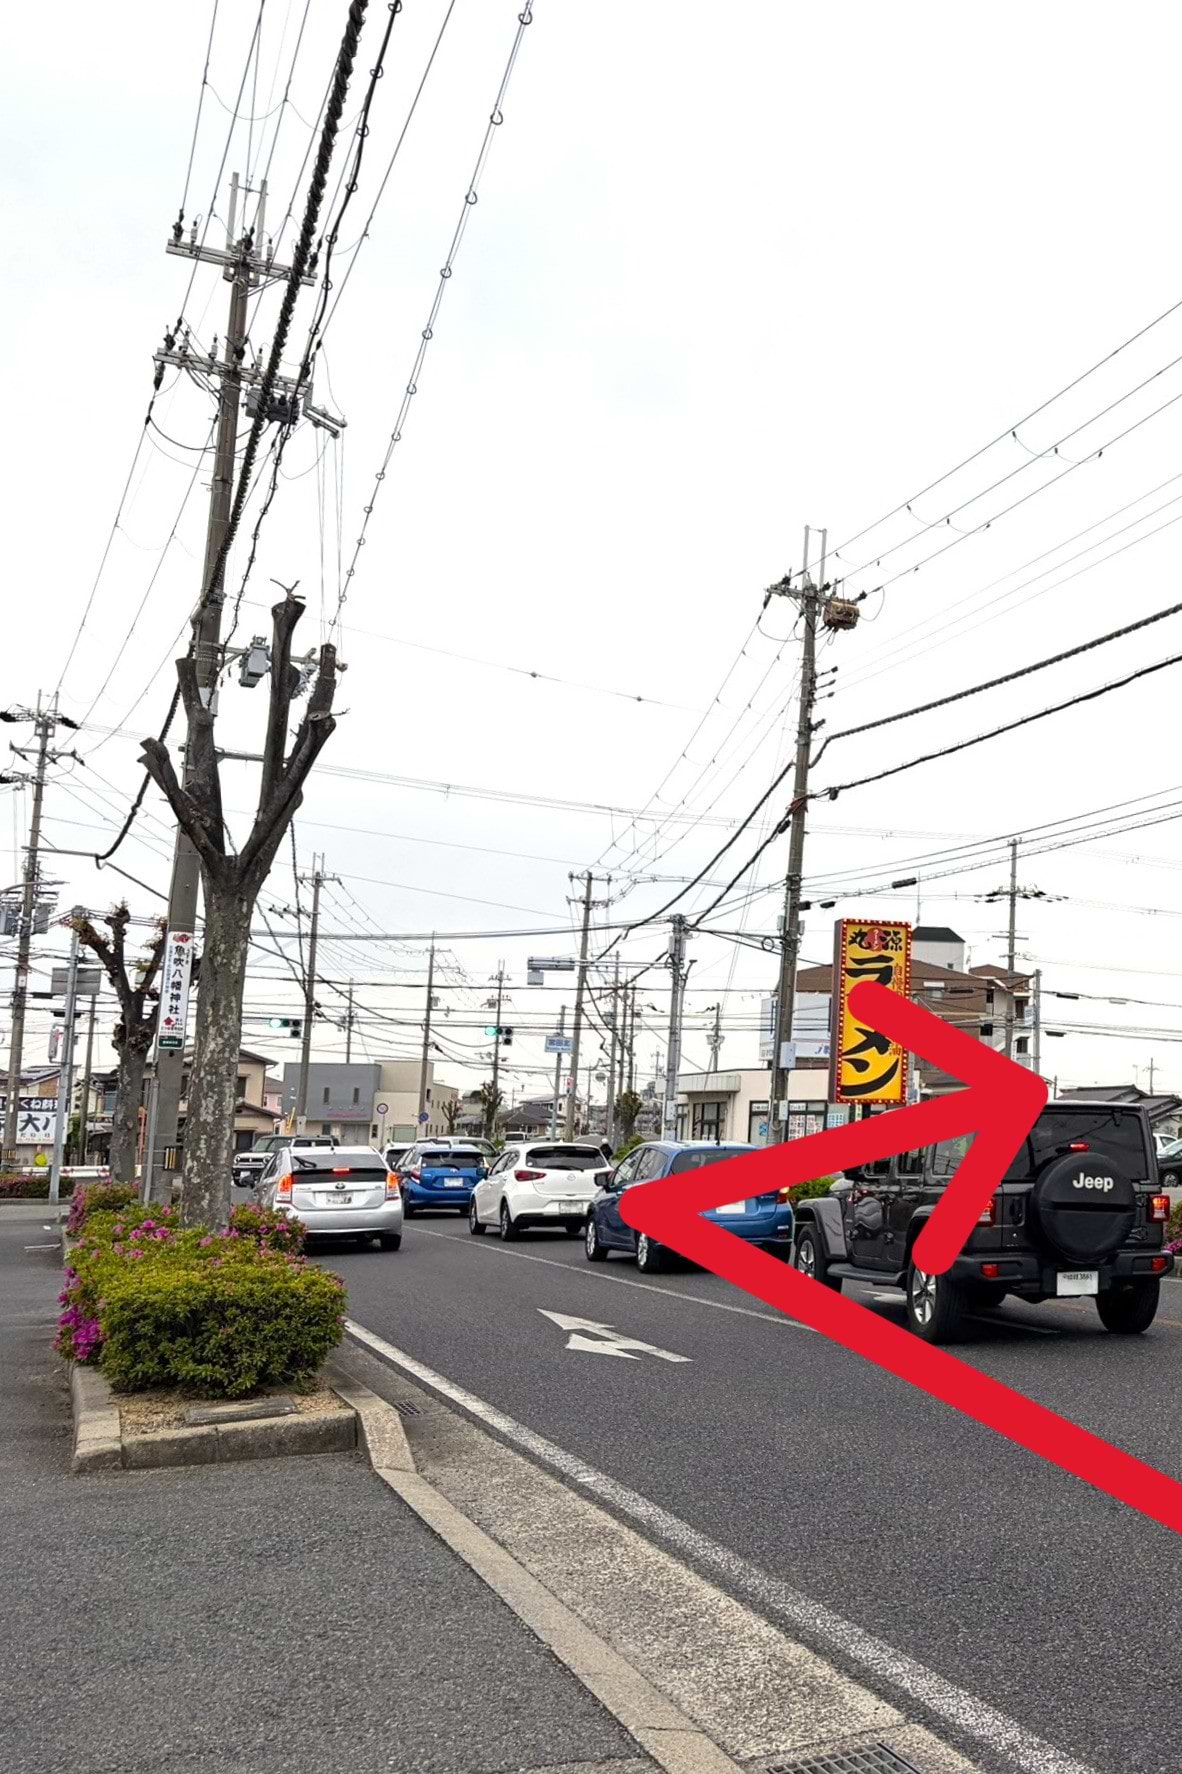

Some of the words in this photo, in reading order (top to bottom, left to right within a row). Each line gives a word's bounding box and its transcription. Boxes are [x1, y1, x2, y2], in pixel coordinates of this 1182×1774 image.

[842, 954, 900, 1096] ラメン
[1072, 1172, 1114, 1192] Jeep
